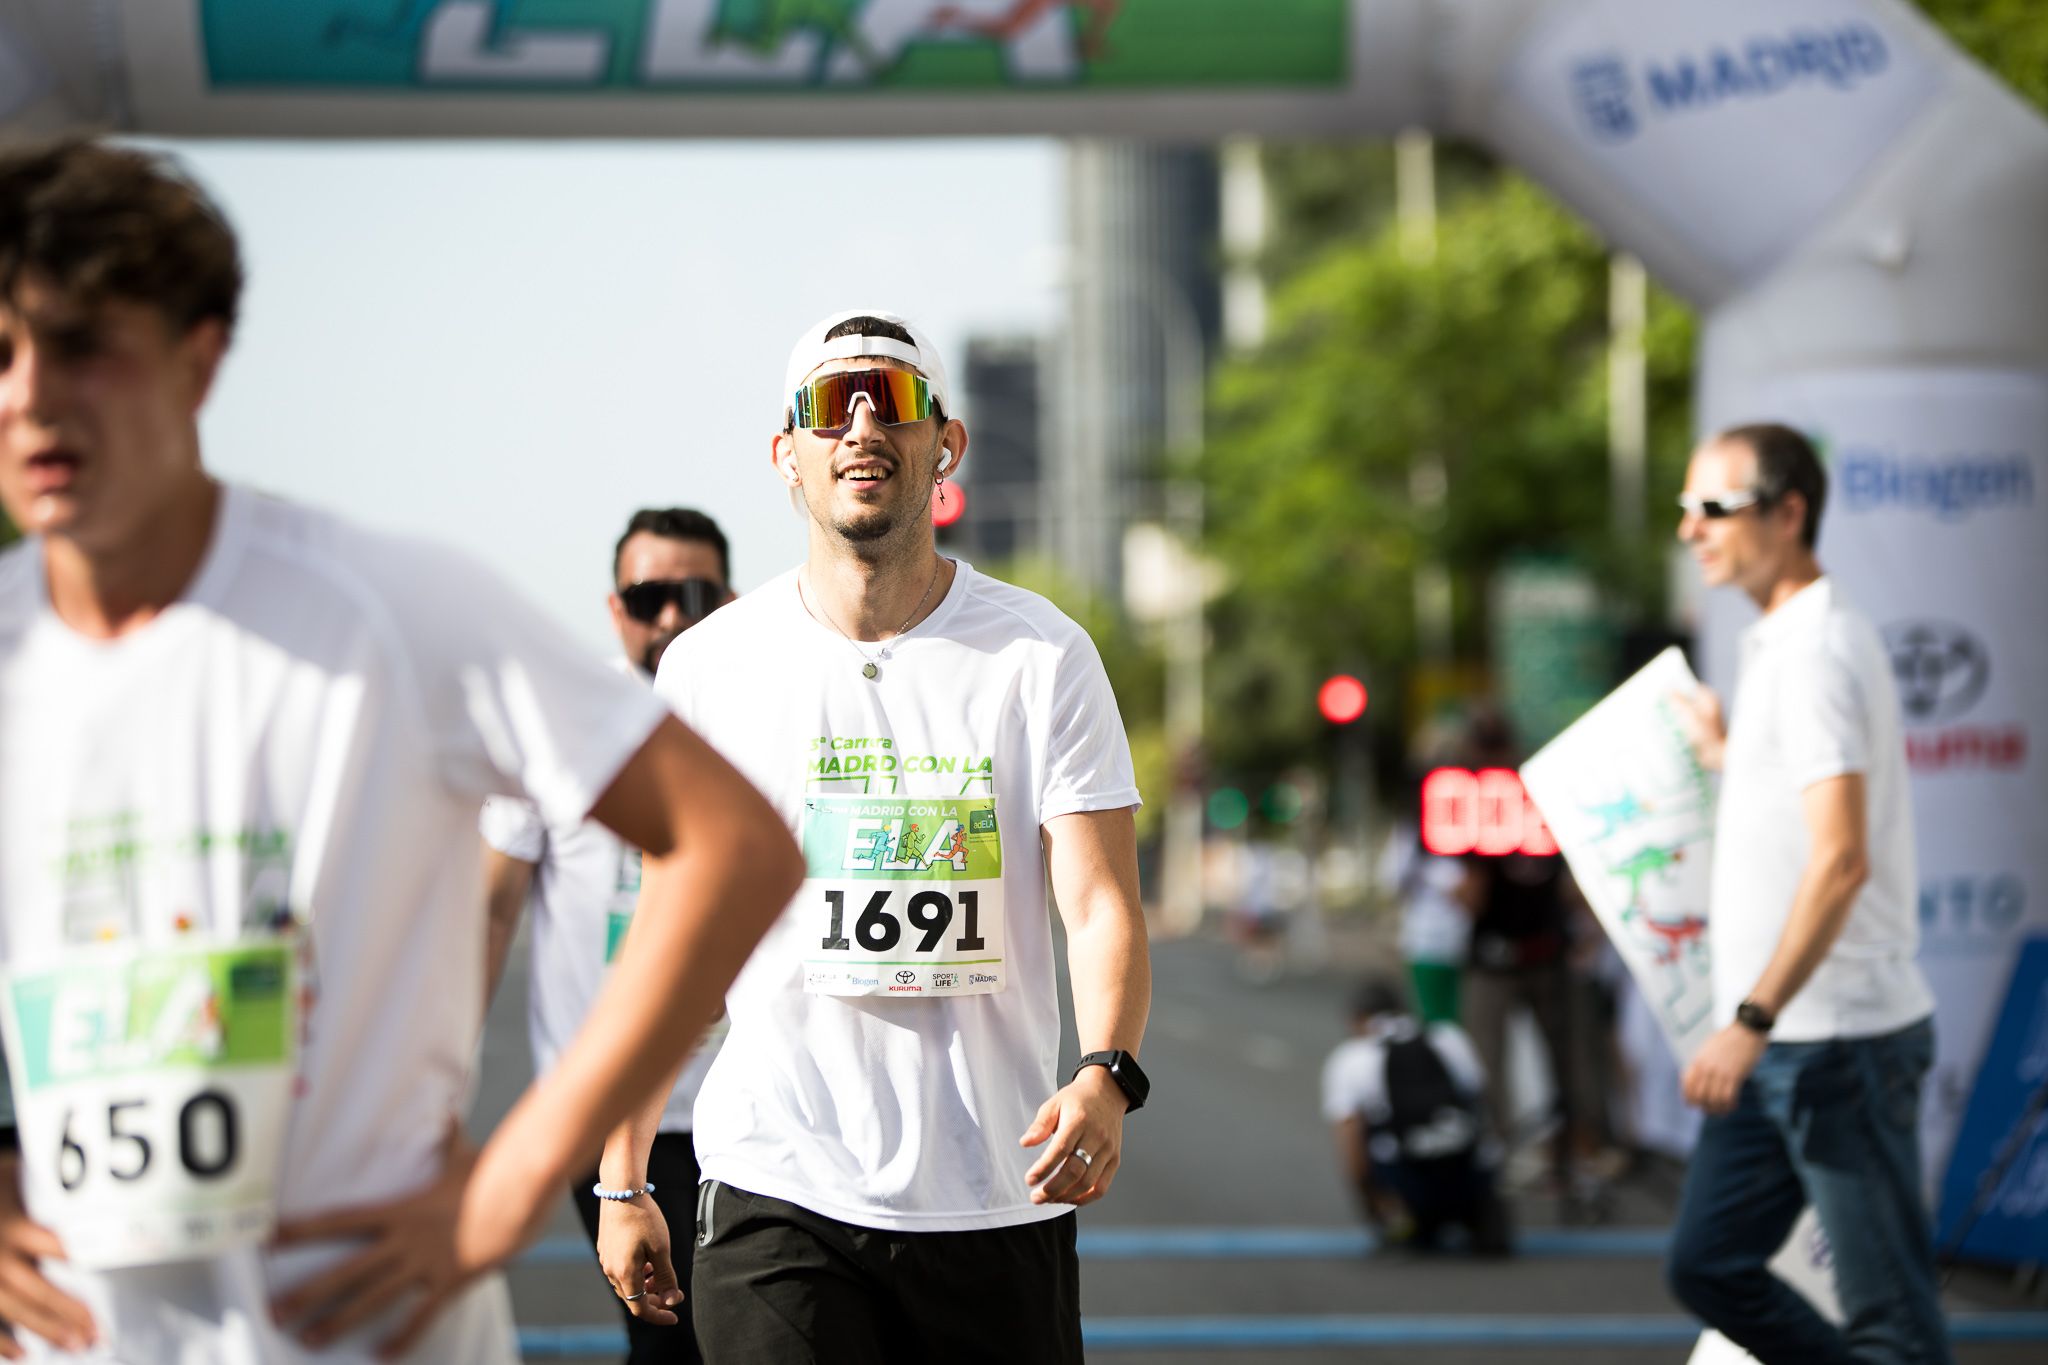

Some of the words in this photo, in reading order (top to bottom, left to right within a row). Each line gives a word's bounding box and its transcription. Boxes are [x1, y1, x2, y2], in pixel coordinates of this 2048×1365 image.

[1648, 24, 1888, 112] MADRID
[1843, 452, 2034, 522] Biogen
[903, 755, 957, 773] CON
[962, 756, 993, 773] LA
[851, 806, 905, 817] MADRID
[908, 806, 938, 817] CON
[941, 806, 958, 817] LA
[841, 818, 967, 871] ELA
[822, 890, 985, 952] 1691
[852, 977, 880, 987] Biogen
[58, 1086, 241, 1192] 650
